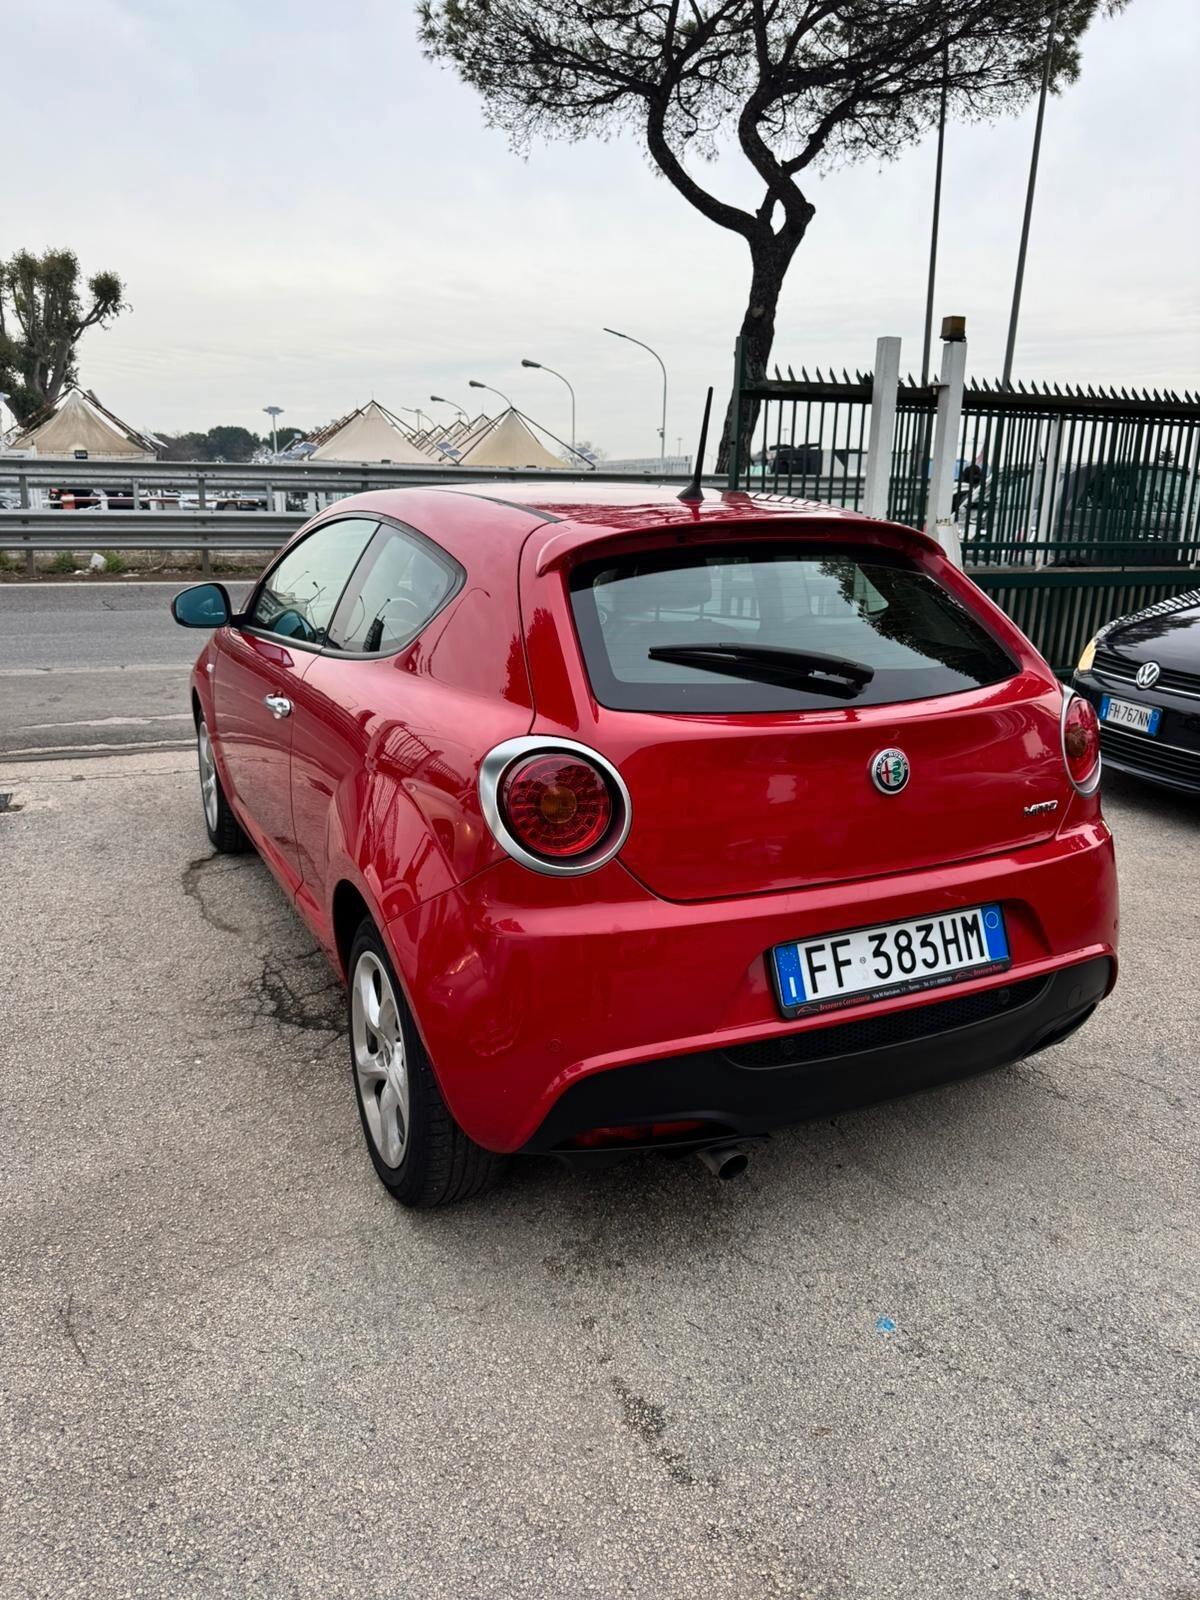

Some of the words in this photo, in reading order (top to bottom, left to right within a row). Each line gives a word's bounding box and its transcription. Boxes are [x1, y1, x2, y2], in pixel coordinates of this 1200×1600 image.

[1108, 702, 1121, 719] FH
[1121, 706, 1152, 727] 767NN
[804, 938, 852, 994] FF
[868, 913, 985, 980] 383HM
